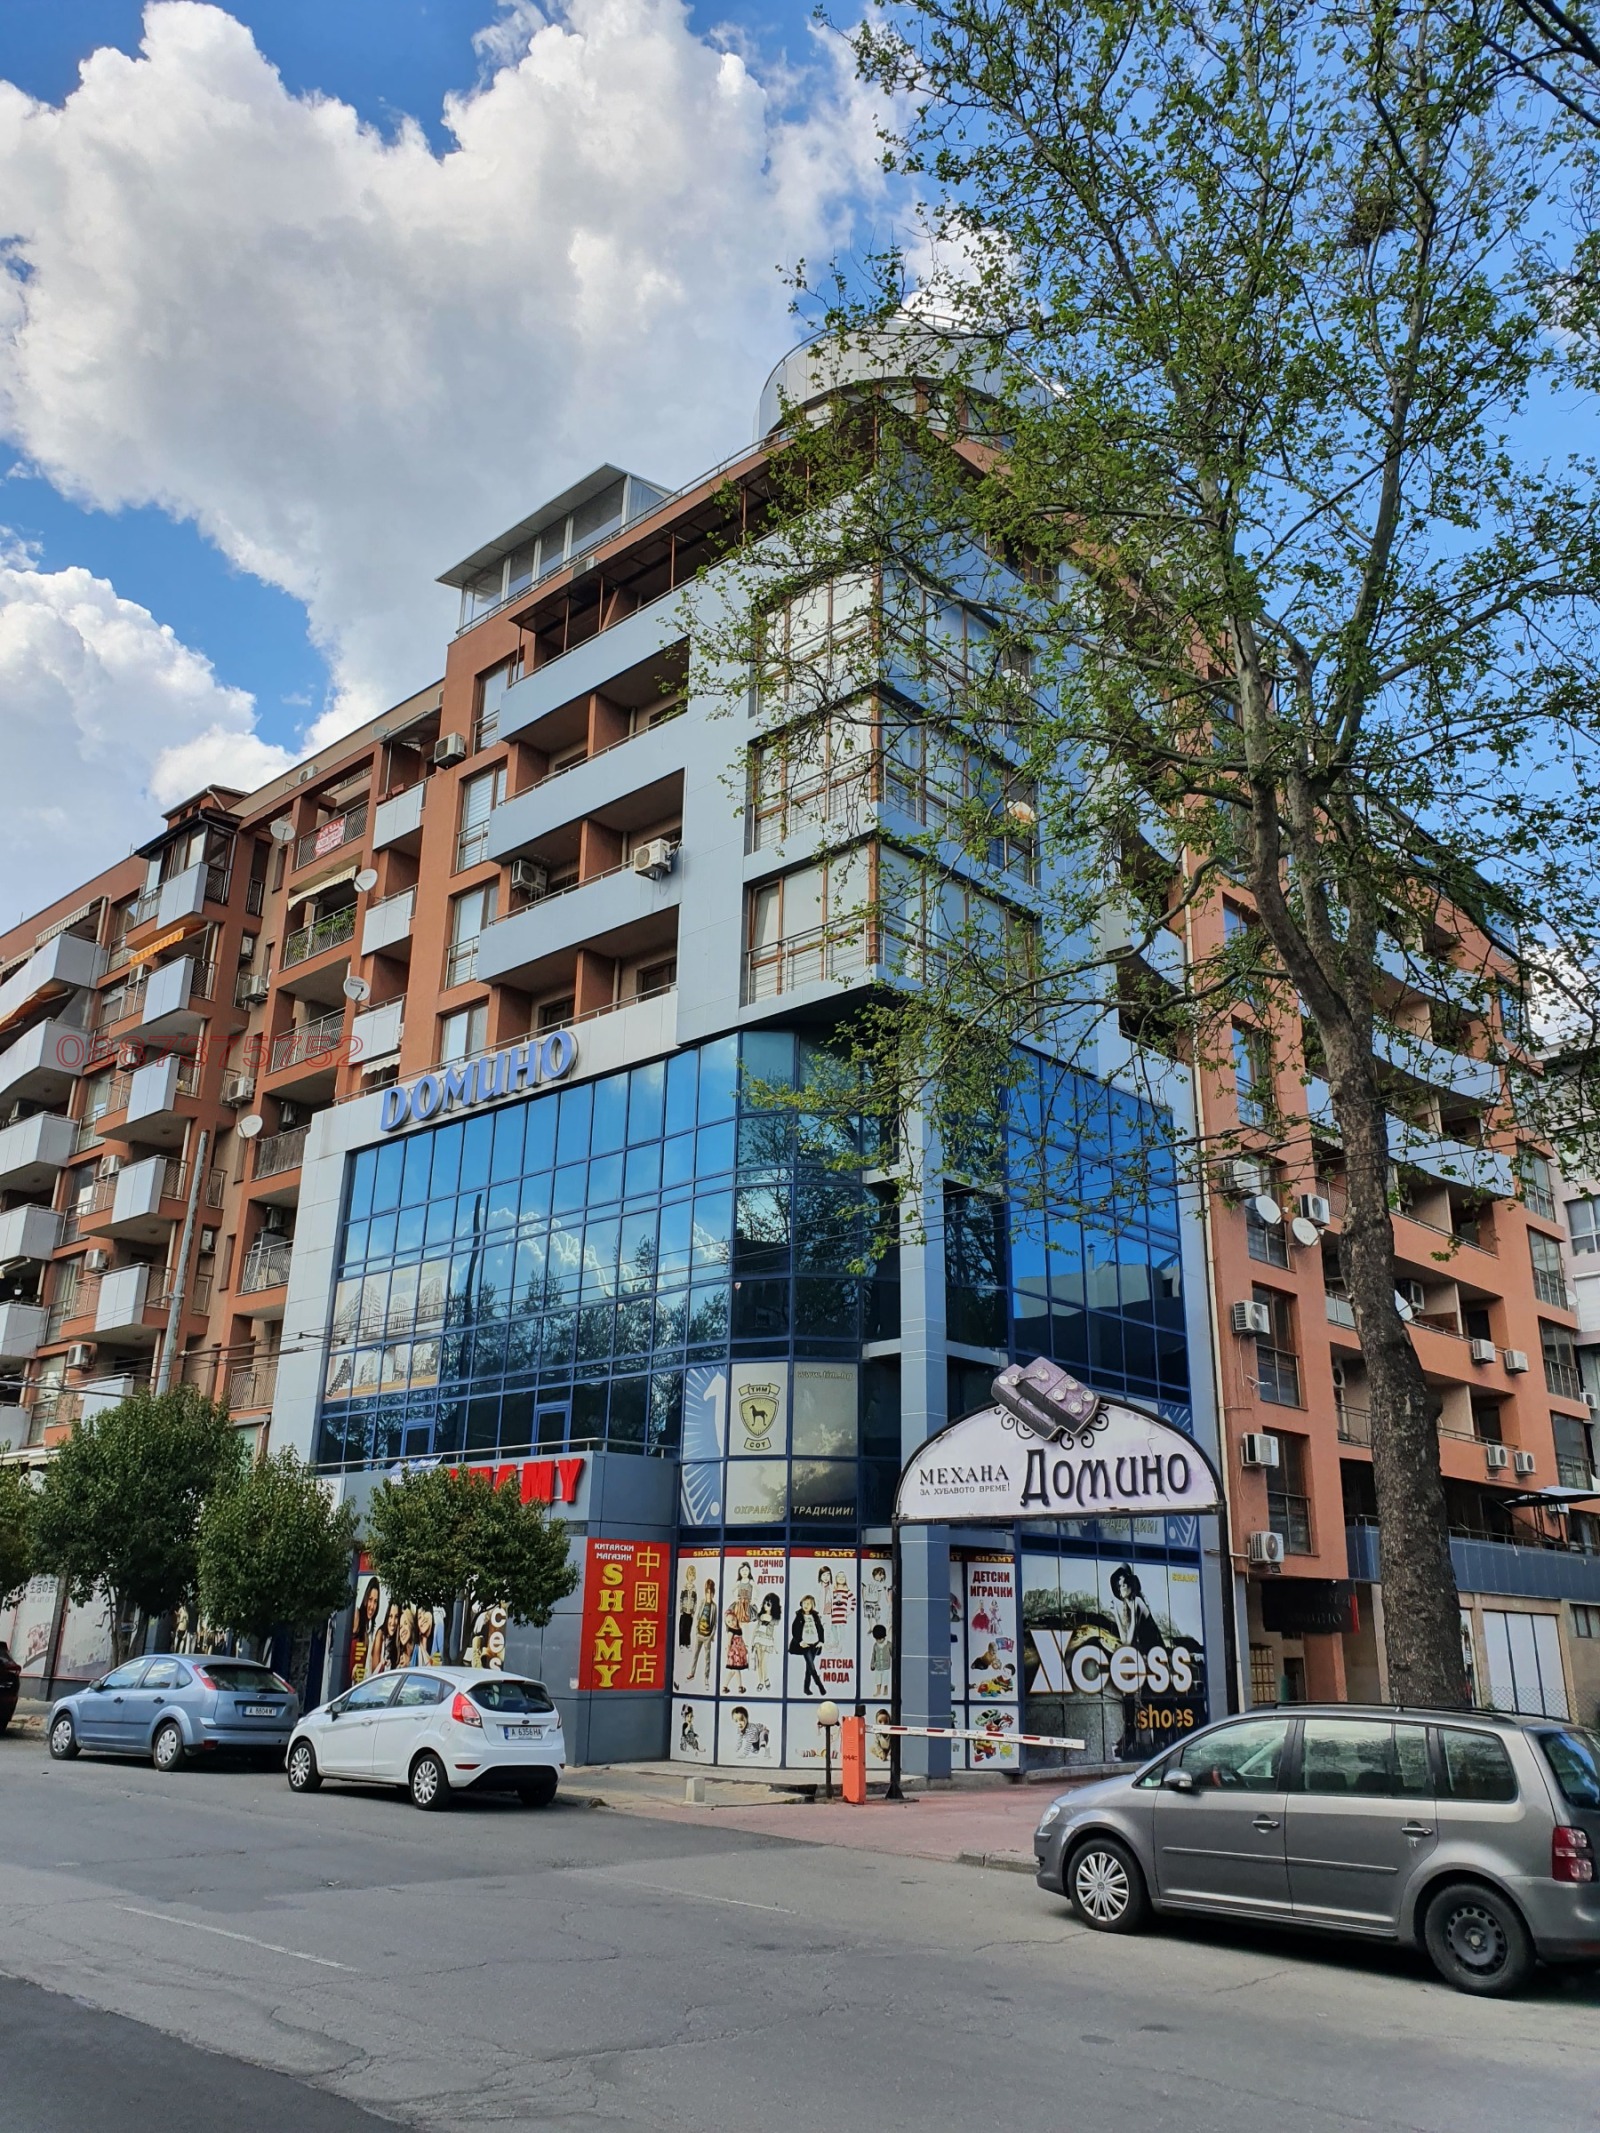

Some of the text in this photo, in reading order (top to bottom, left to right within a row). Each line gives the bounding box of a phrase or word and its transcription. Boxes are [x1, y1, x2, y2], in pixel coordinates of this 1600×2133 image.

[749, 1441, 766, 1449] СОТ
[919, 1464, 1009, 1485] МЕХАНА
[449, 1458, 584, 1504] AMY
[934, 1486, 975, 1495] ХУБАВОТО
[979, 1481, 1010, 1493] ВРЕМЕ!
[793, 1505, 854, 1516] ТРАДИЦИИ!
[594, 1543, 634, 1552] КИТАЙСКИ
[745, 1549, 785, 1557] SHAMY
[596, 1552, 632, 1561] МАГАЗИН
[814, 1550, 855, 1558] SHAMY
[975, 1555, 1014, 1563] SHAMY
[753, 1559, 784, 1568] ВСИЧКО
[757, 1576, 784, 1584] ДЕТЕТО
[972, 1570, 1010, 1584] ДЕТСКИ
[970, 1585, 1013, 1598] ИГРАЧКИ
[629, 1545, 661, 1684] 中國商店
[593, 1563, 625, 1688] SHAMY
[819, 1658, 854, 1670] ДЕТСКА
[1029, 1629, 1193, 1694] Xcess
[823, 1672, 850, 1683] МОДА
[1138, 1703, 1194, 1729] shoes
